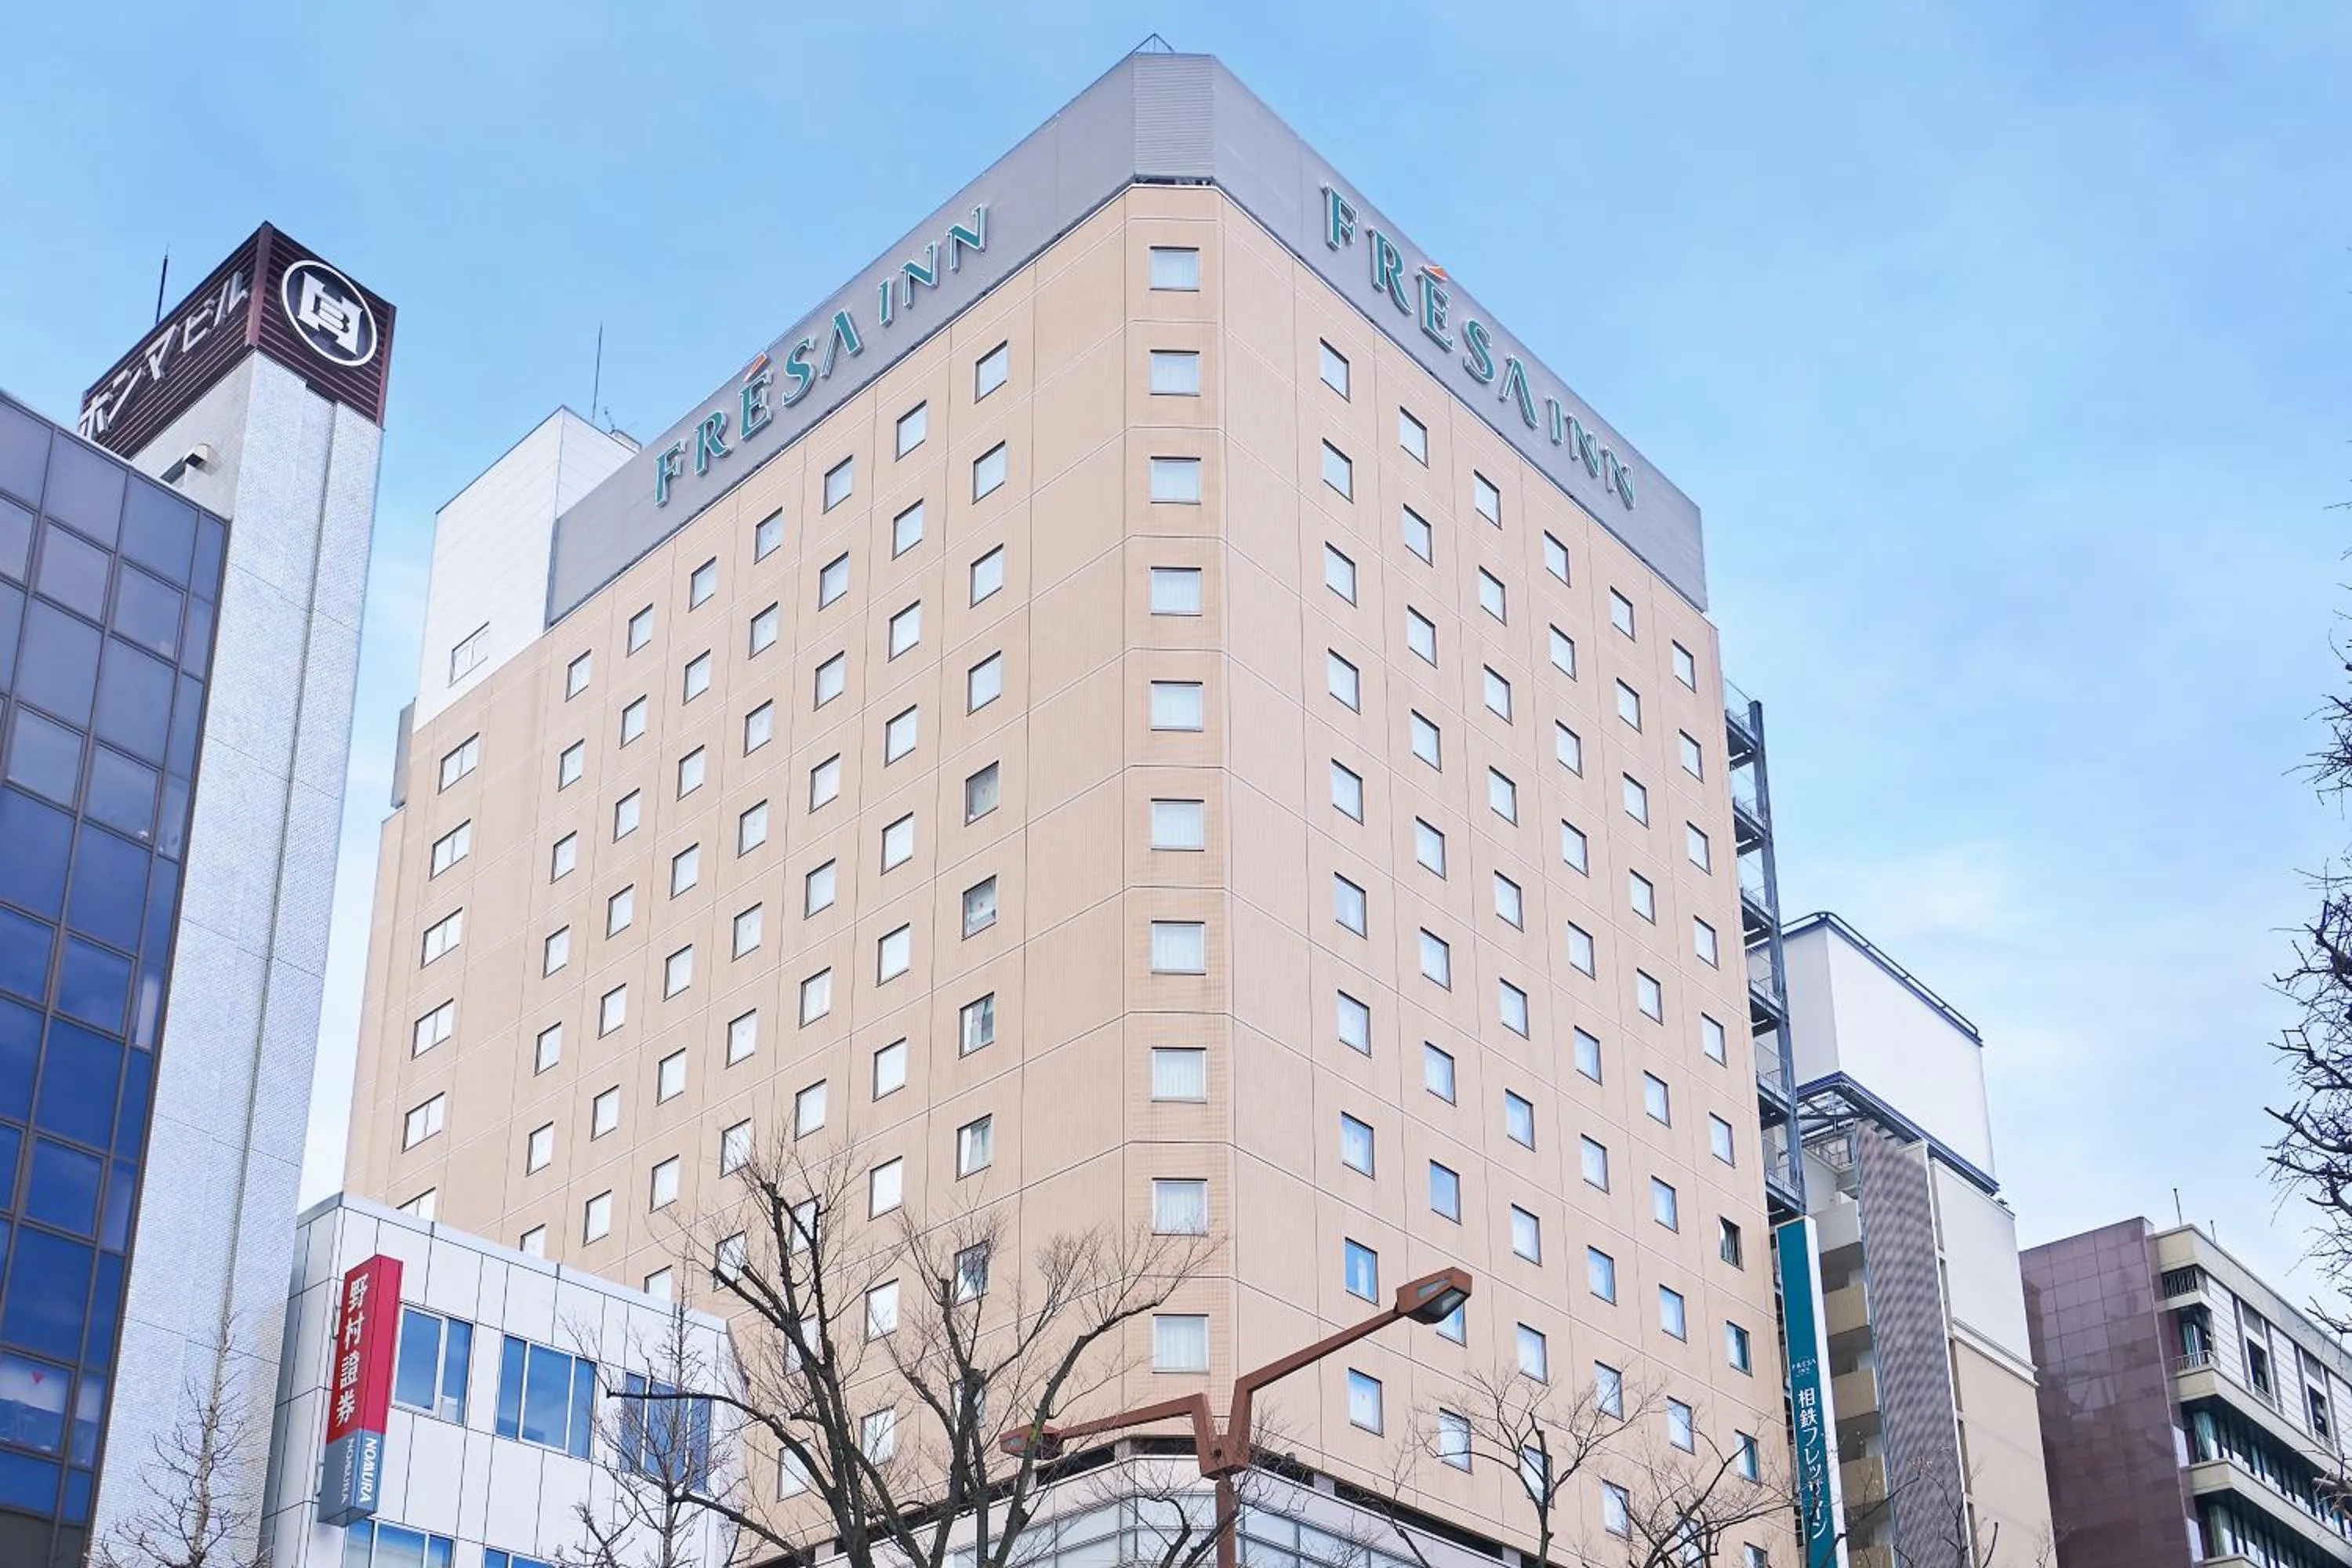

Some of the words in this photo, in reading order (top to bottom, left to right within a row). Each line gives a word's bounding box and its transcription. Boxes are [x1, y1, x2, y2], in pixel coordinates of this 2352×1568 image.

[878, 204, 989, 326] INN
[79, 273, 249, 441] ホンマビル
[1547, 397, 1635, 510] INN
[336, 1272, 369, 1428] 野村證券
[359, 1437, 376, 1503] NOMURA
